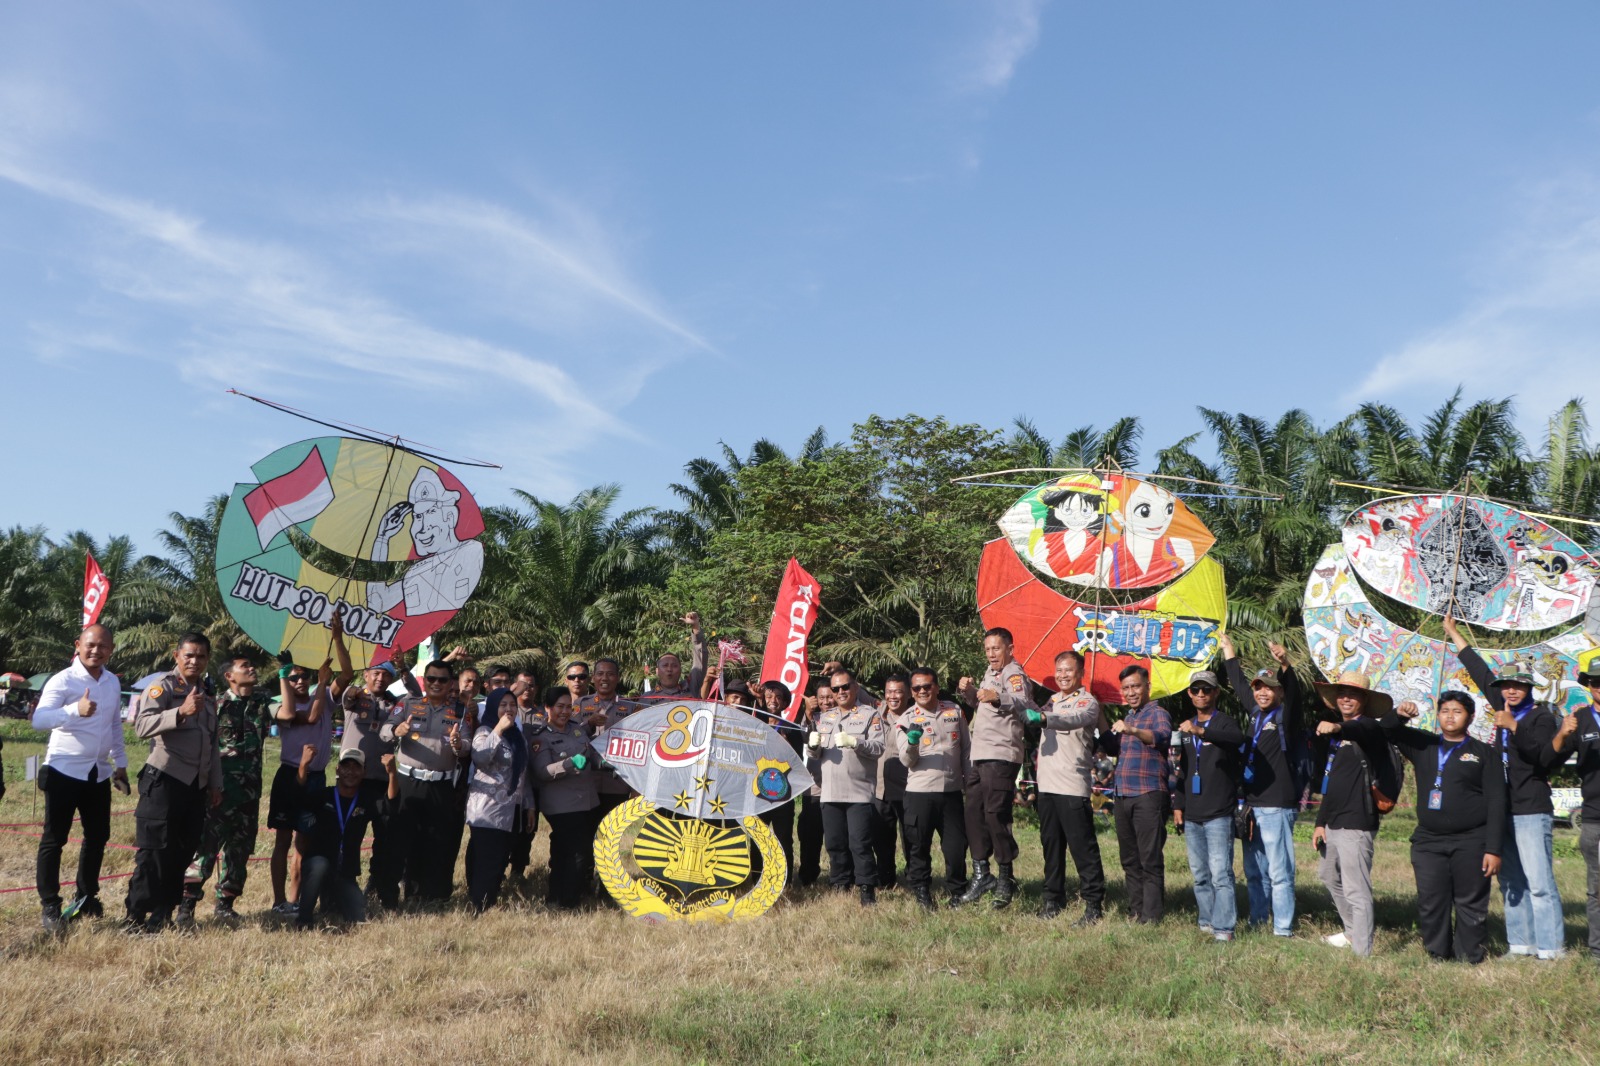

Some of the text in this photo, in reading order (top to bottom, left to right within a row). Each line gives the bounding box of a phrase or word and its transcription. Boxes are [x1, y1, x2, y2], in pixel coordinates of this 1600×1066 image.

[235, 567, 399, 647] HUT 80 POLRI
[611, 738, 645, 759] 110
[660, 705, 714, 758] 80
[641, 878, 667, 900] rastra
